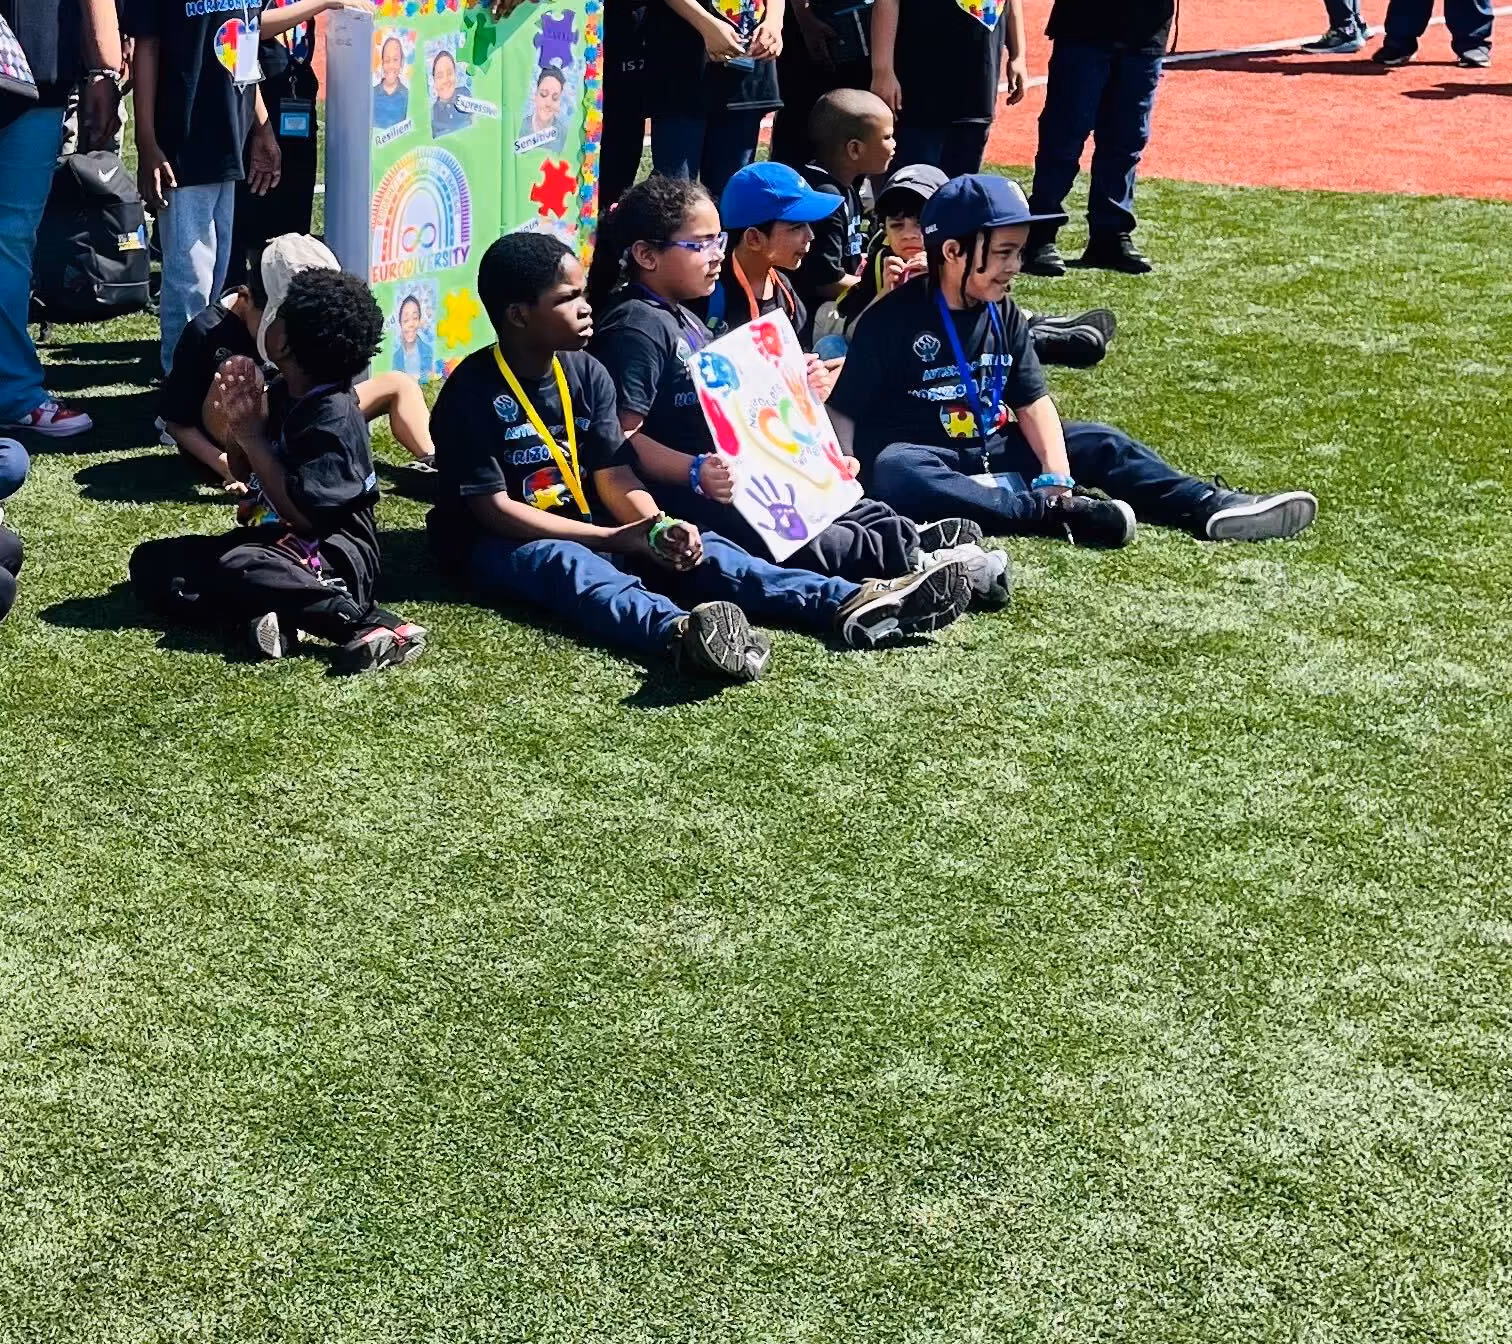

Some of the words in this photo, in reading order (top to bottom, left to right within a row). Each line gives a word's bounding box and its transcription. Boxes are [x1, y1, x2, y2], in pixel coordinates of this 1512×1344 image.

[454, 95, 498, 117] Expressive
[375, 120, 413, 146] Resilient
[514, 128, 558, 152] Sensitive
